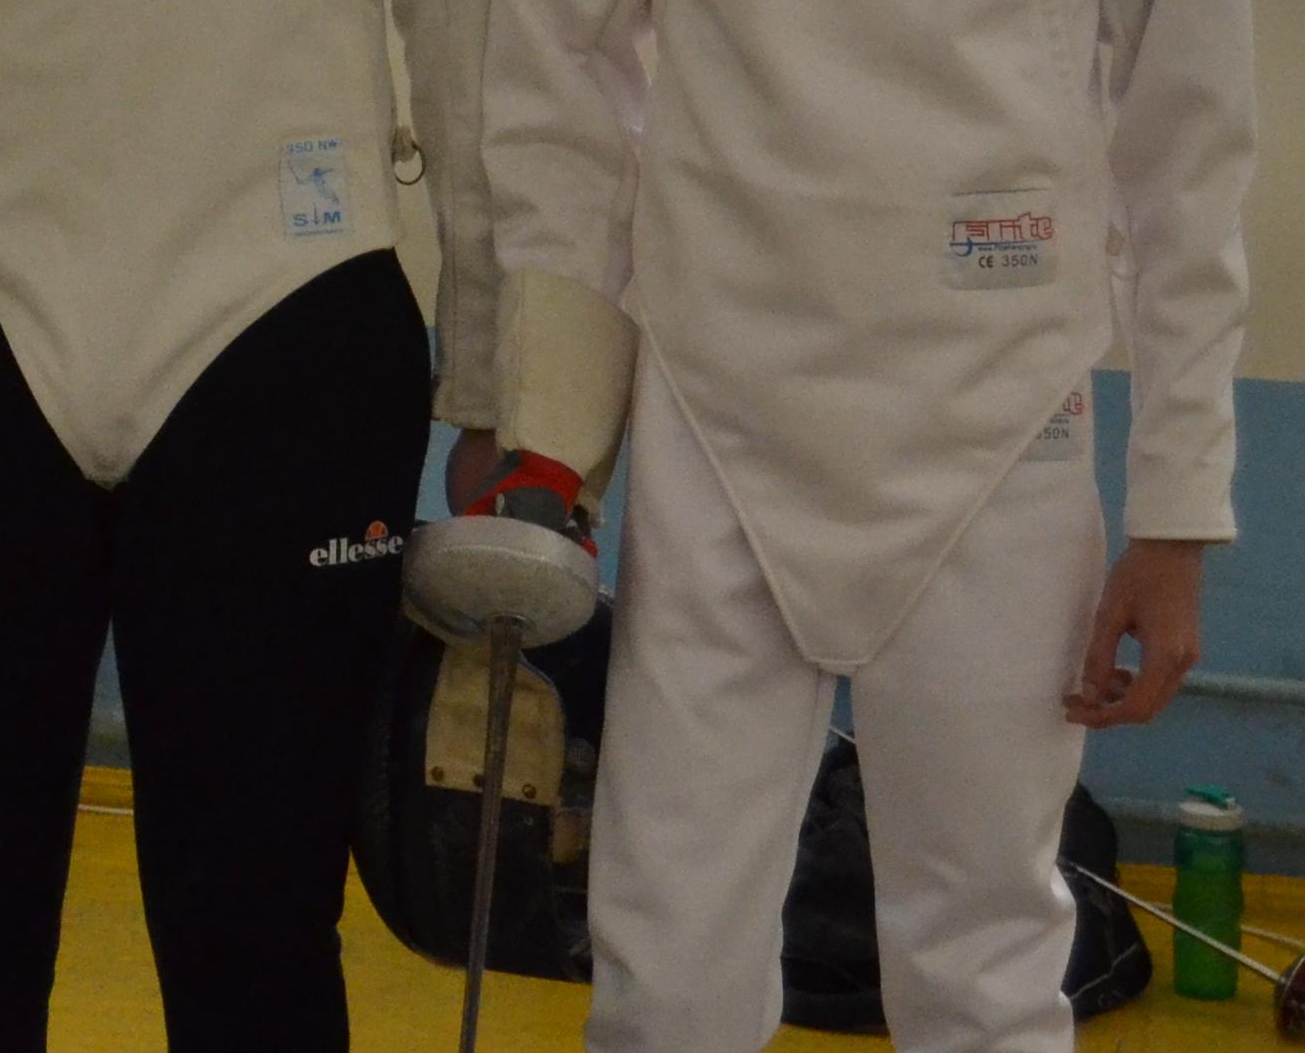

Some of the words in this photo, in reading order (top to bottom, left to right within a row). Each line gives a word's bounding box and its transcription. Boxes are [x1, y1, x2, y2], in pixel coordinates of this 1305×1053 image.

[978, 255, 994, 268] CE
[1001, 254, 1039, 268] 350N
[309, 534, 404, 566] ellesse
